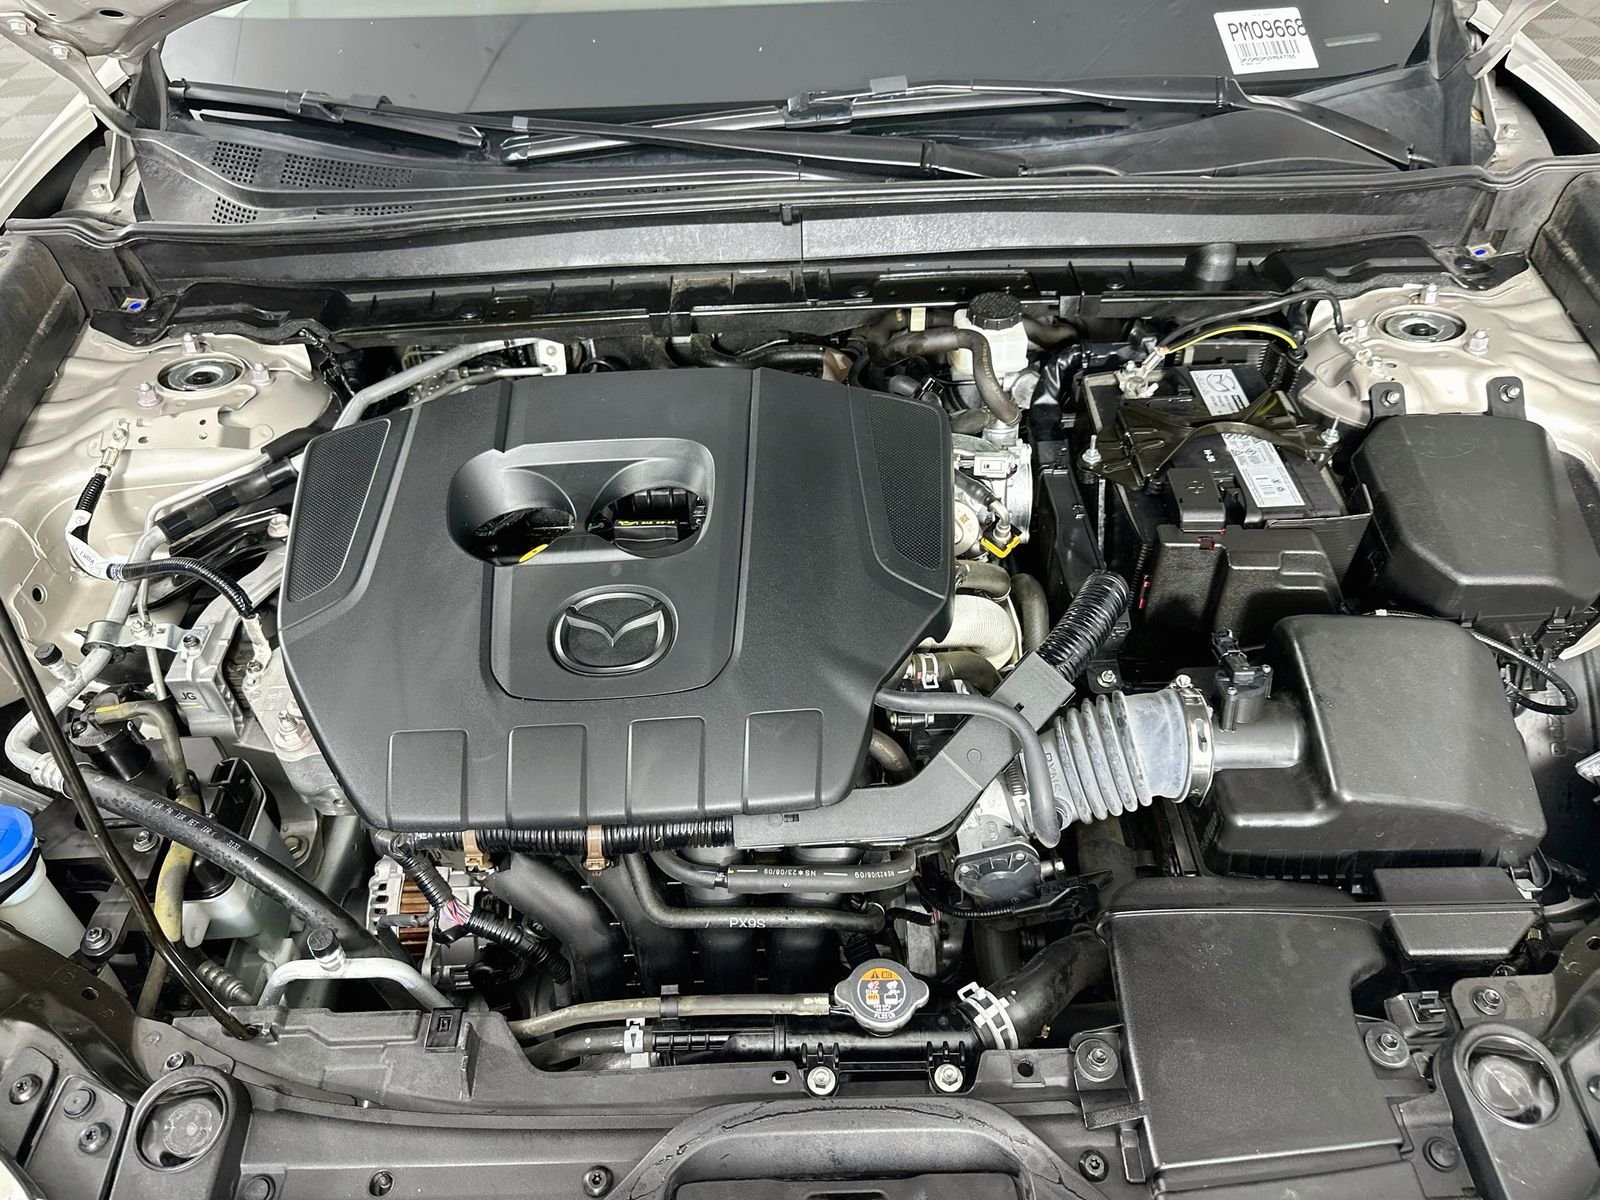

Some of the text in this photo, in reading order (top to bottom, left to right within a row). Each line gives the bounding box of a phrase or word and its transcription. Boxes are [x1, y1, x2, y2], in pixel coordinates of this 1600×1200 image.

[1227, 18, 1307, 41] PM09668
[181, 692, 197, 700] JG
[729, 917, 766, 928] PX9S
